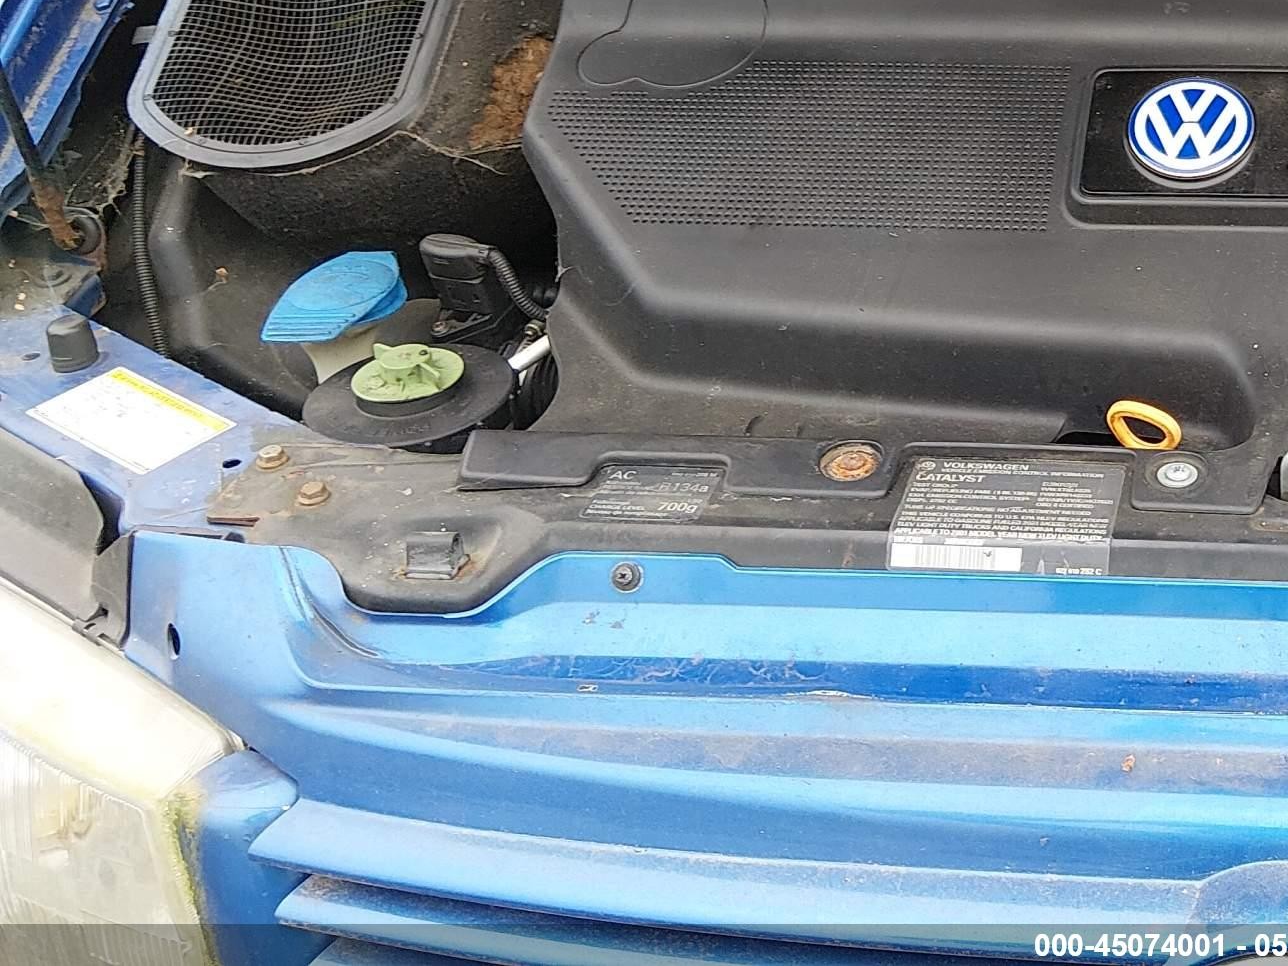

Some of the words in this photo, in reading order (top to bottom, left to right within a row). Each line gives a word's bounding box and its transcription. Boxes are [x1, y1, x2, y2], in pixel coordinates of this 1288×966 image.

[1128, 77, 1255, 181] VW
[943, 461, 1030, 472] VOLKSWAGEN
[609, 470, 638, 480] AC
[916, 473, 987, 483] CATALYST
[656, 502, 699, 515] 700g
